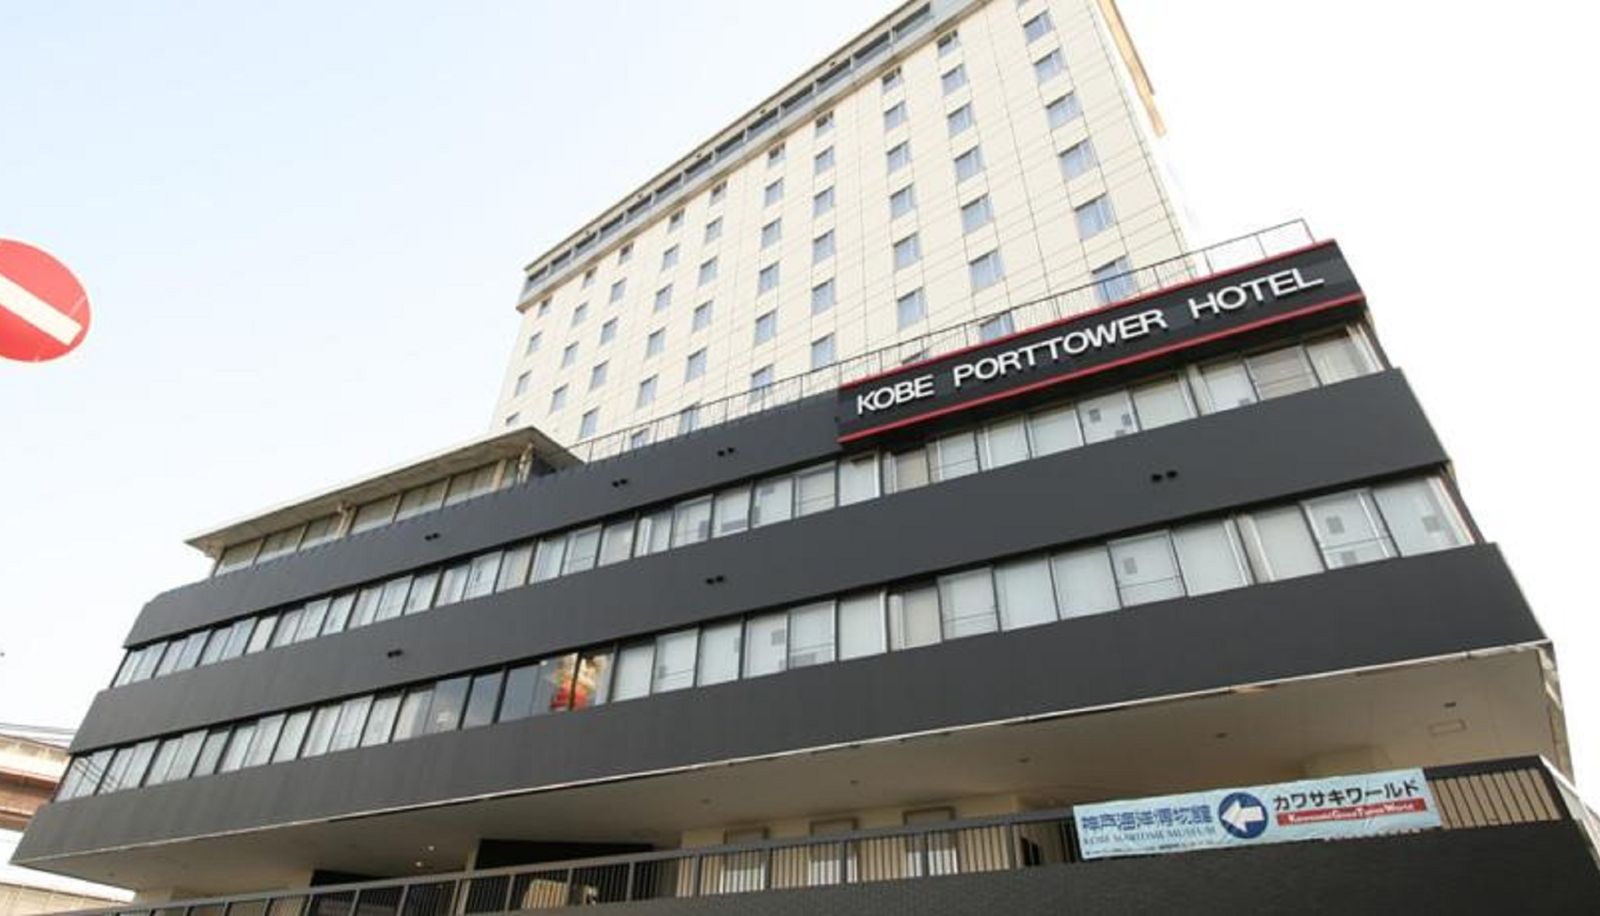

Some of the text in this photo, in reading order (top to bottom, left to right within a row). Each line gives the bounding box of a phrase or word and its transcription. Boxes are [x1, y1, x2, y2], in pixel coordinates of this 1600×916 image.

[855, 267, 1325, 415] KOBE PORTTOWER HOTEL
[1274, 780, 1418, 811] カワサキワールド
